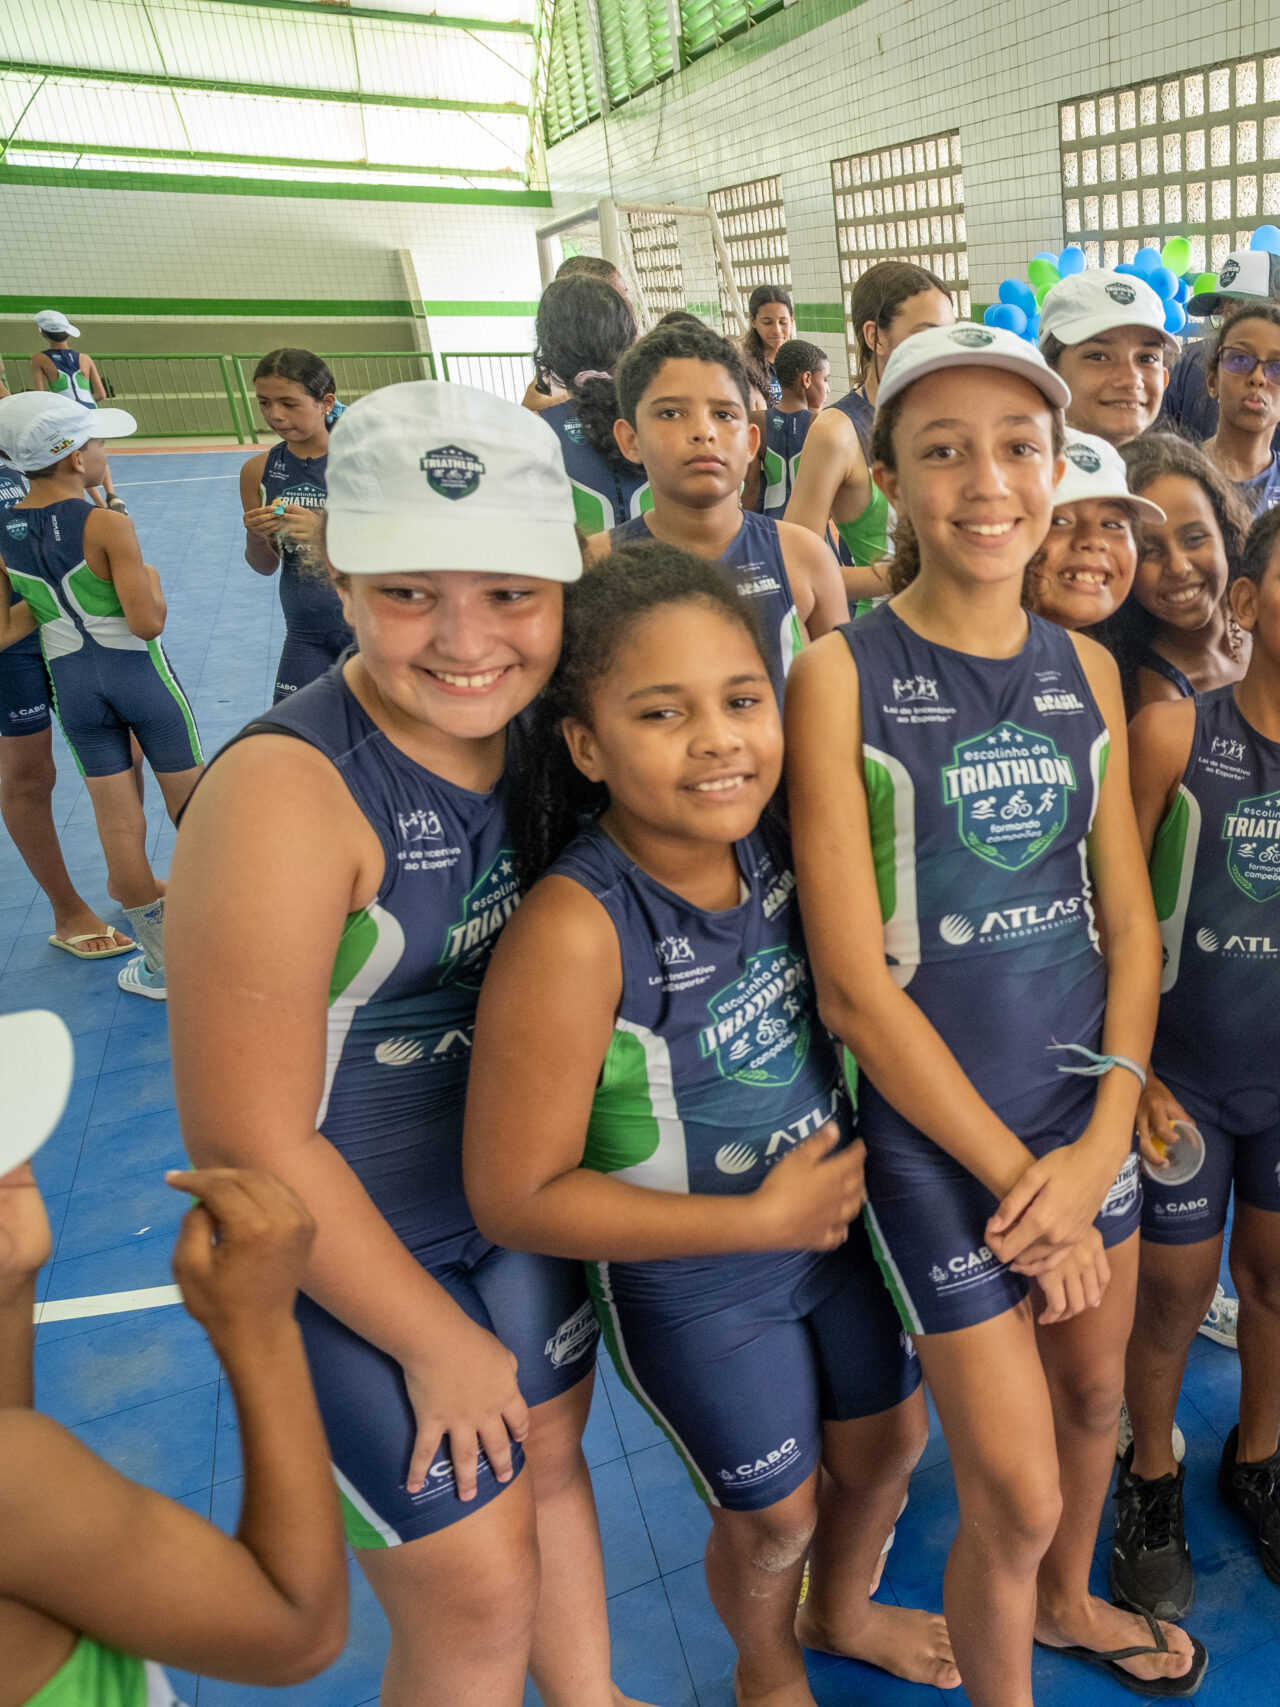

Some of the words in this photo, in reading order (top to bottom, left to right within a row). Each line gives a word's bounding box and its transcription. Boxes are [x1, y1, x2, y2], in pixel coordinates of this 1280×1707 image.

[422, 458, 484, 473] TRIATHLON
[277, 496, 327, 508] TRIATHLO
[737, 577, 782, 597] BRASIL
[19, 703, 46, 716] CABO
[1033, 694, 1085, 712] BRASIL
[963, 749, 1030, 762] escolinha
[1031, 744, 1049, 755] de
[1219, 762, 1251, 776] Incentivo
[946, 758, 1074, 799] TRIATHLON
[990, 819, 1041, 833] formando
[980, 896, 1082, 934] ATLAS
[771, 957, 788, 973] de
[1166, 1197, 1209, 1213] CABO
[948, 1246, 993, 1273] CAB
[736, 1437, 796, 1476] CABO
